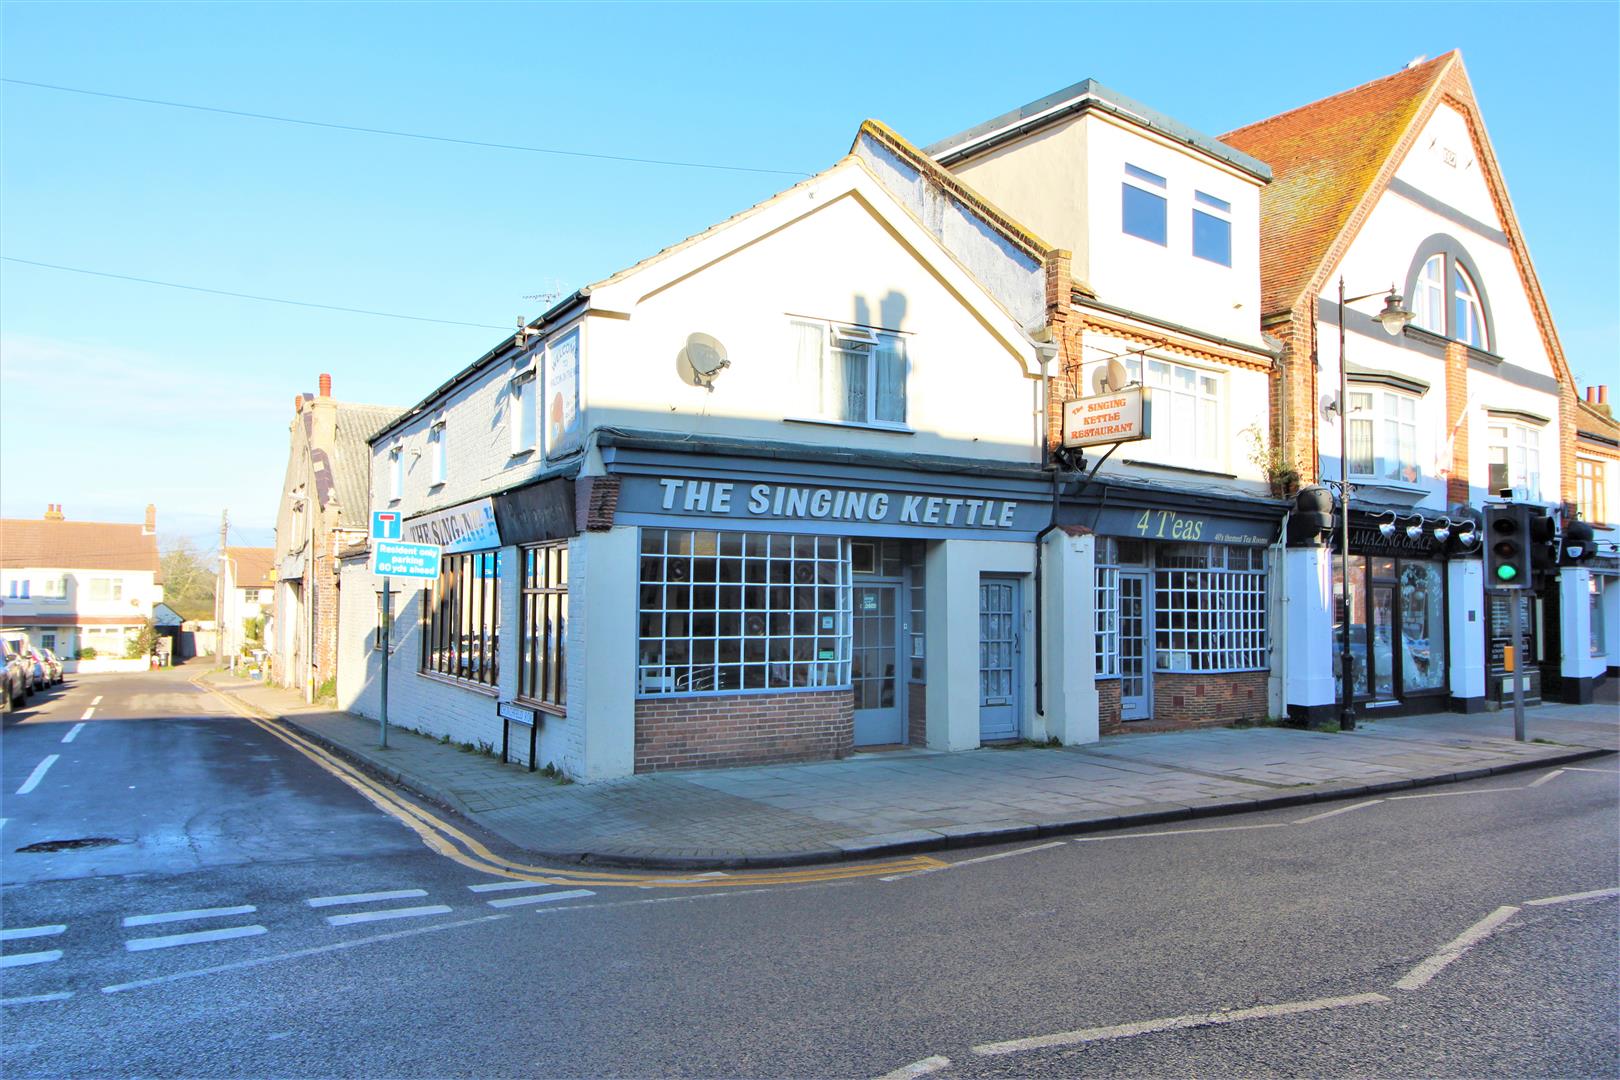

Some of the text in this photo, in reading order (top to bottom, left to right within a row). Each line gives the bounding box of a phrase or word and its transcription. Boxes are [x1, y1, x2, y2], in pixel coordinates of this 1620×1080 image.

[1087, 398, 1126, 412] SINGING
[1083, 412, 1121, 425] KETTLE
[1071, 422, 1133, 439] RESTAURANT
[660, 478, 1017, 528] THE SINGING KETTLE
[1136, 509, 1151, 536] 4
[380, 544, 438, 559] Resident only
[391, 555, 424, 567] parking
[392, 565, 407, 573] yds
[409, 566, 435, 575] ahead
